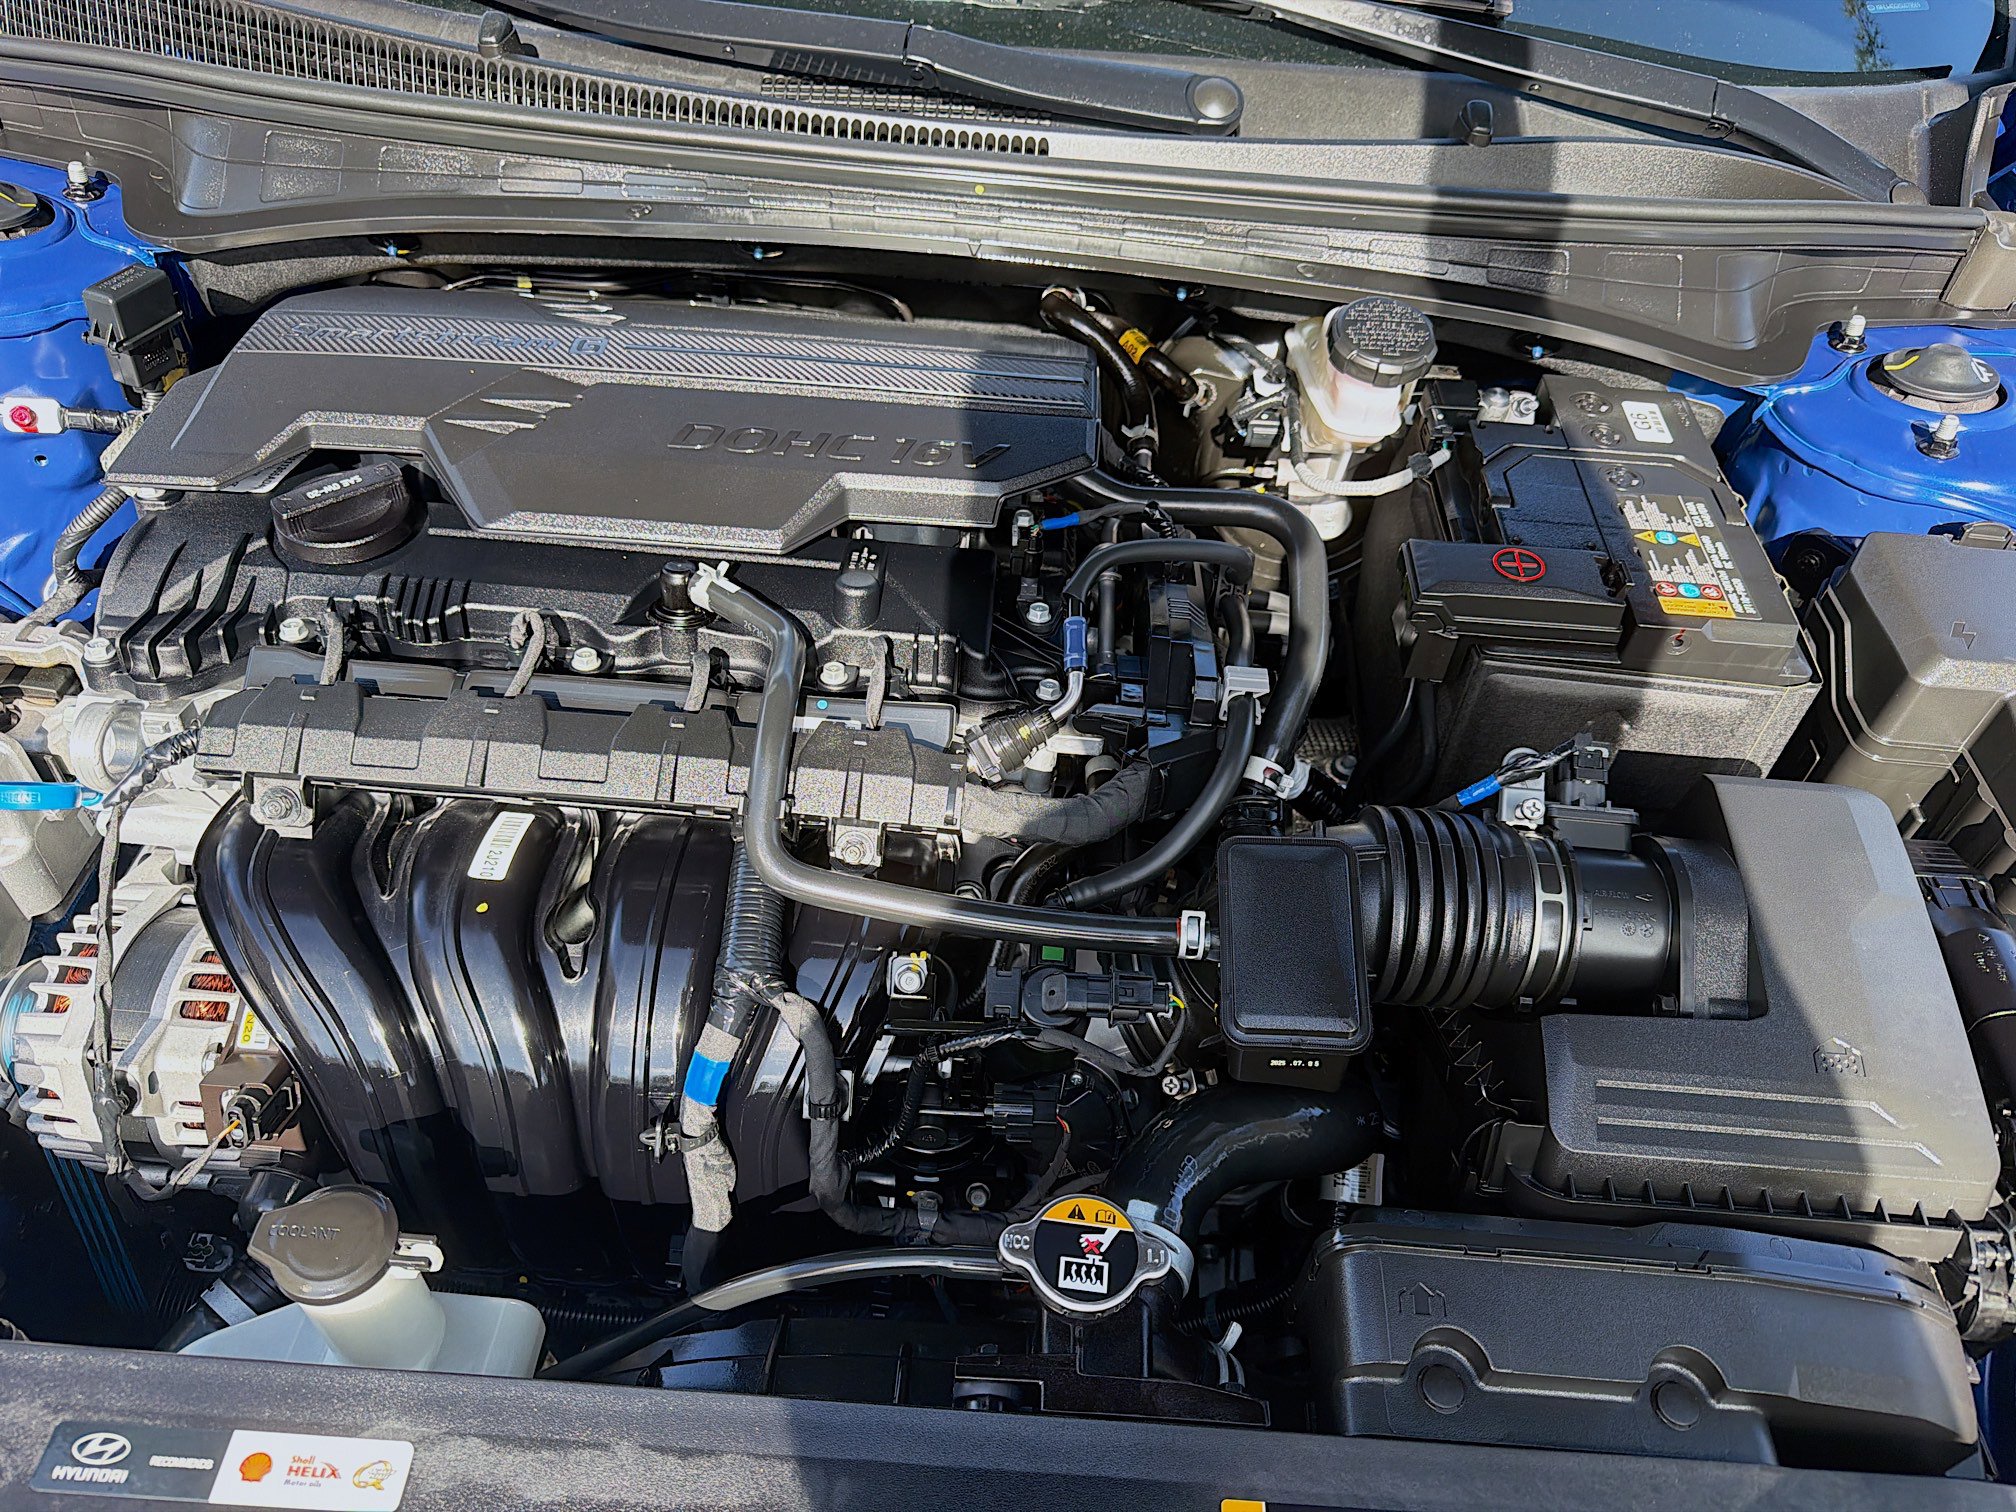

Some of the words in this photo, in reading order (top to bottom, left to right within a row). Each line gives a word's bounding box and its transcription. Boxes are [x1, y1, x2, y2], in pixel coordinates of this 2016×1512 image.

[289, 323, 560, 351] Smartstream
[666, 422, 877, 461] DOHC
[306, 480, 342, 499] 0W-20
[338, 474, 363, 489] SAE
[269, 1224, 341, 1240] COOLANT
[1004, 1233, 1030, 1251] HCC
[1146, 1248, 1165, 1265] 1.1
[292, 1455, 316, 1465] Shell
[52, 1465, 130, 1484] HYUNDAI
[286, 1463, 341, 1480] HELIX
[284, 1479, 307, 1487] Motor
[309, 1480, 322, 1488] oils
